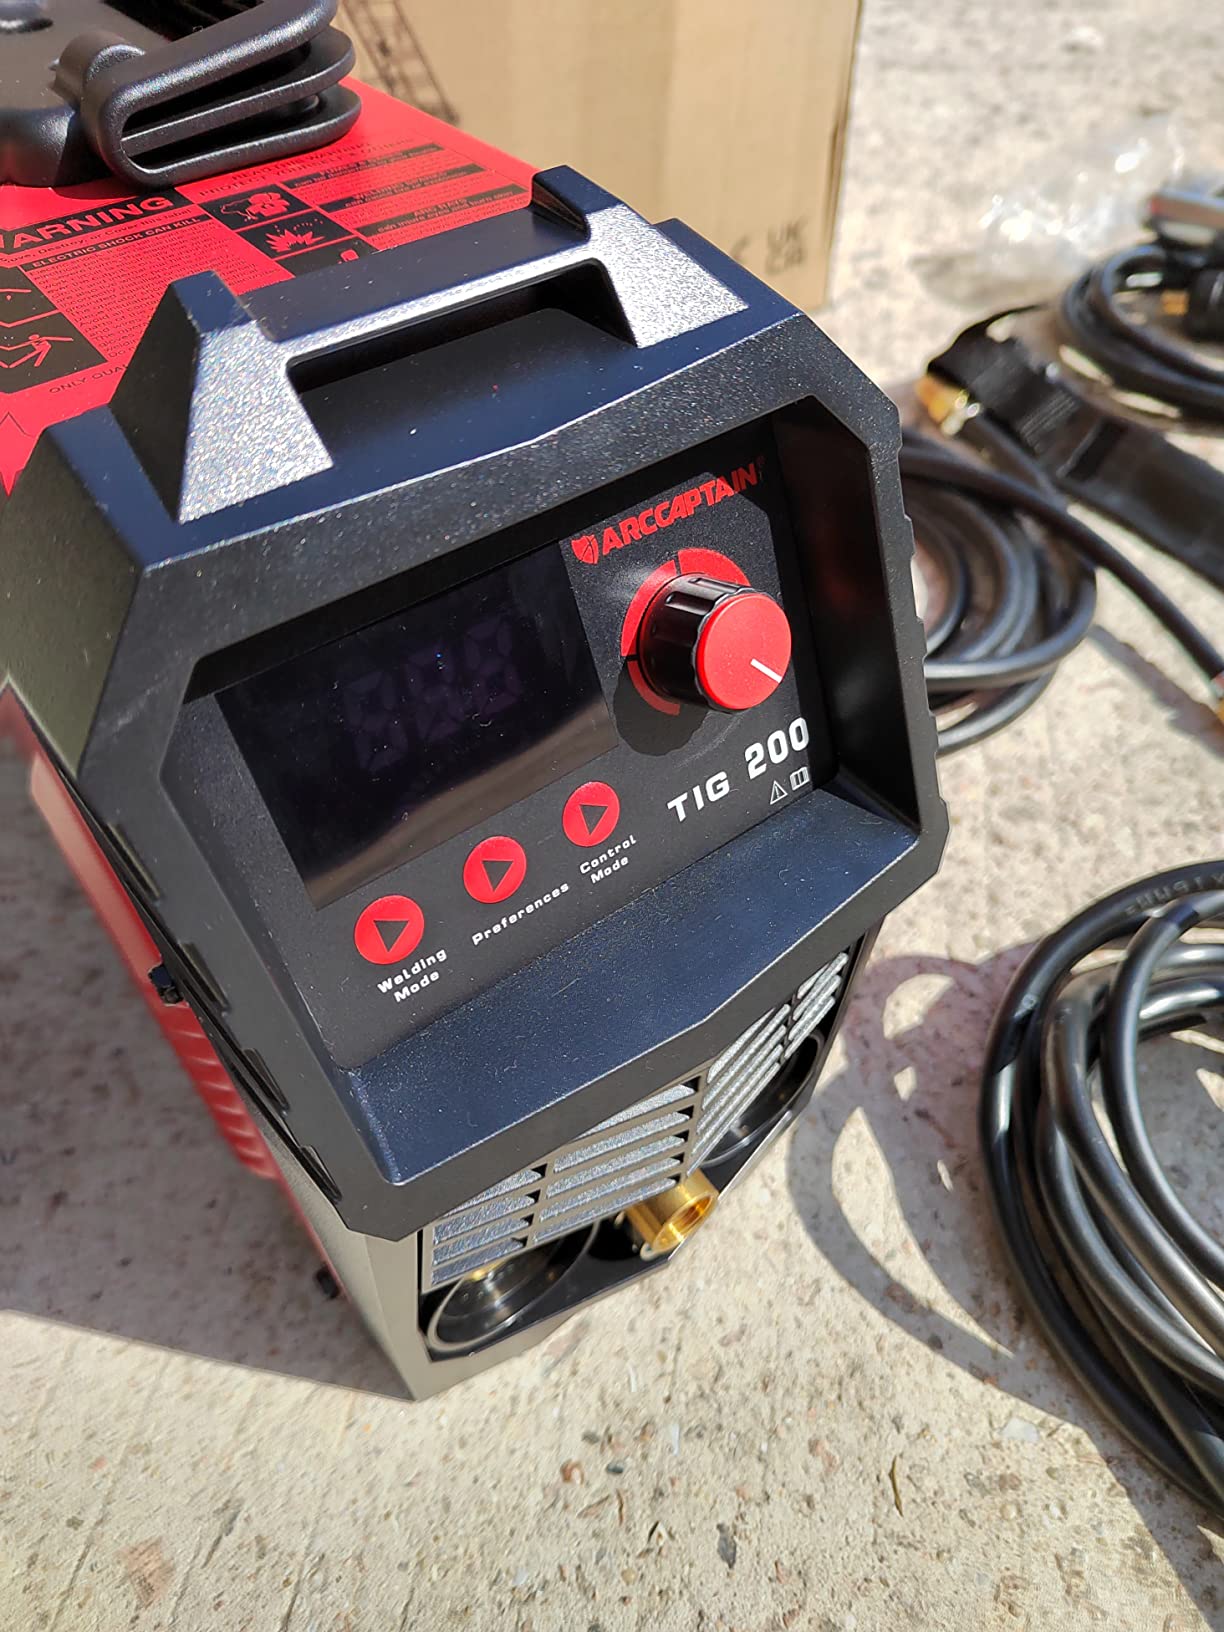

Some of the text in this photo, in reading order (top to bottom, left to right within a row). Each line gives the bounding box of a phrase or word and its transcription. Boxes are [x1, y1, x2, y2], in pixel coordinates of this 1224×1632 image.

[0, 196, 174, 249] ARNING
[32, 218, 201, 268] ELECTRIC SHOCK CAN KILL
[49, 377, 87, 394] ONLY
[602, 463, 758, 556] ARCCAPTAIN
[666, 717, 810, 823] TIG 200
[579, 834, 637, 874] Control
[590, 856, 629, 884] Mode
[471, 882, 570, 946] Preferences
[377, 949, 448, 994] Welding
[393, 971, 440, 1003] Mode
